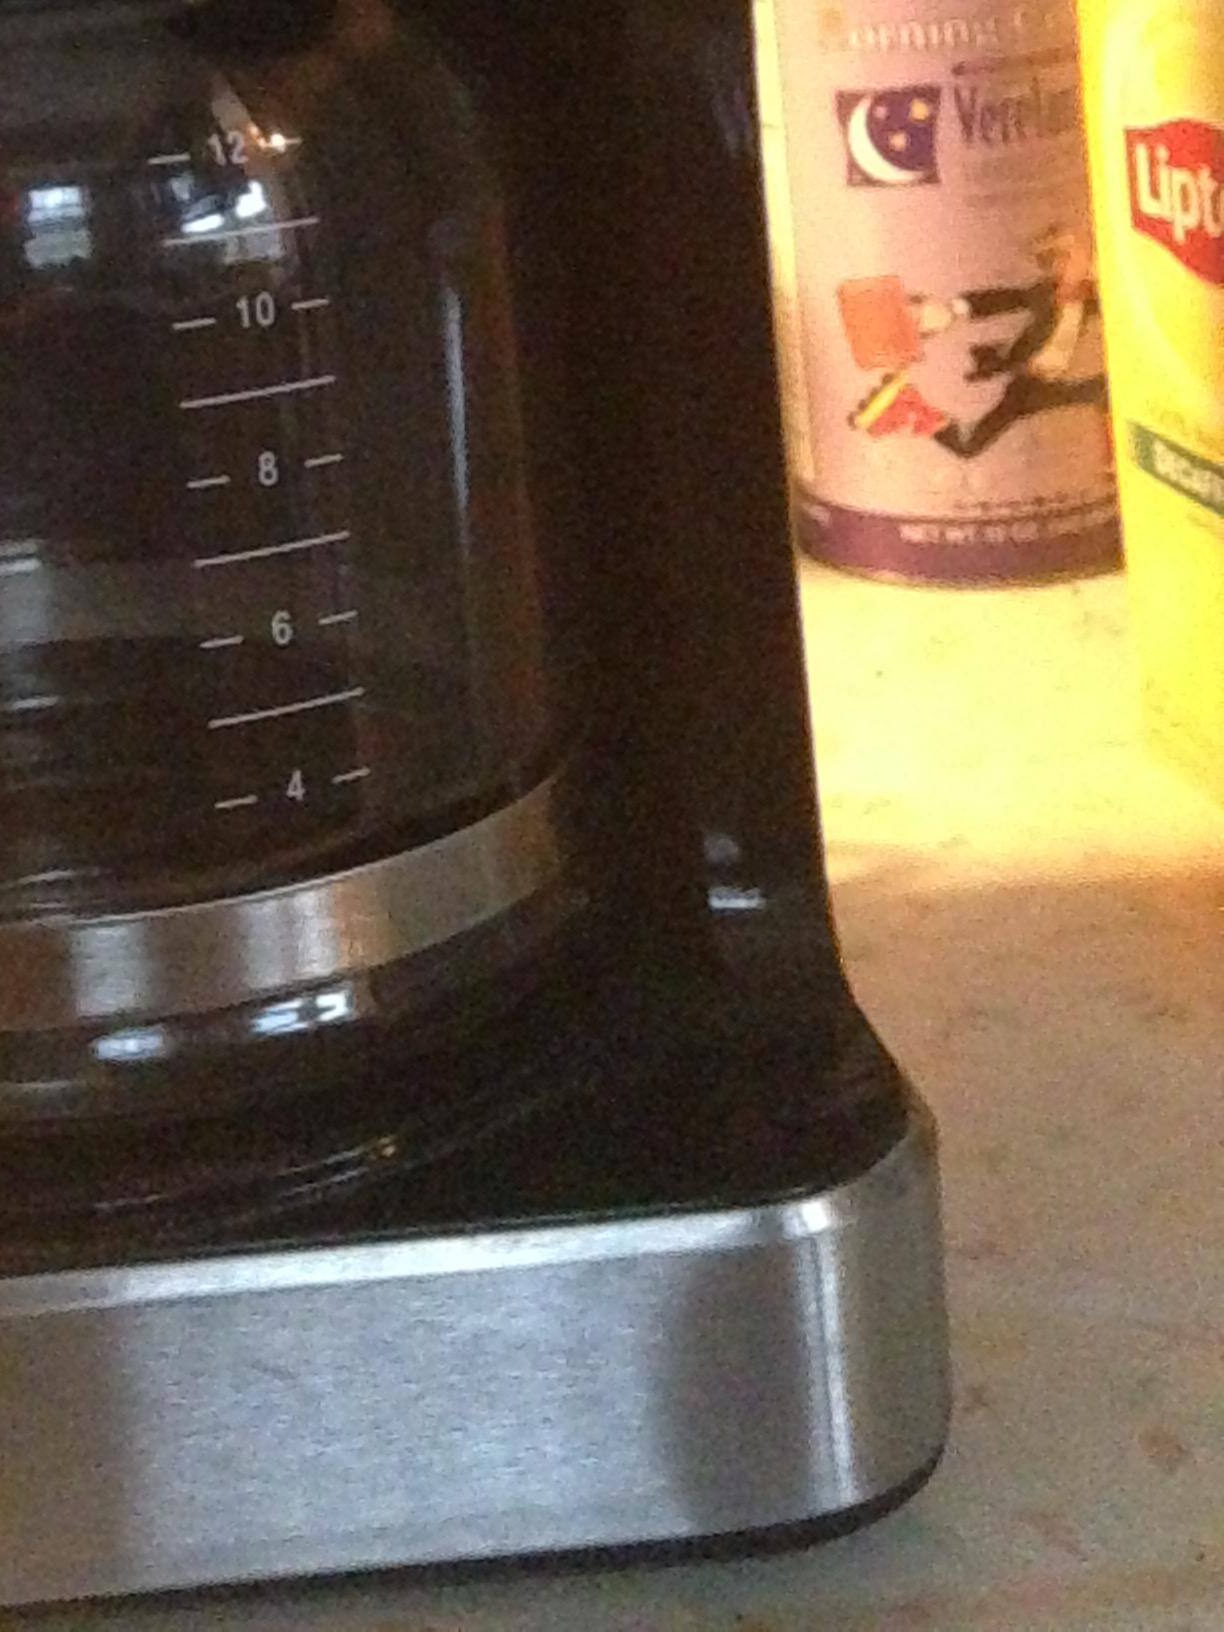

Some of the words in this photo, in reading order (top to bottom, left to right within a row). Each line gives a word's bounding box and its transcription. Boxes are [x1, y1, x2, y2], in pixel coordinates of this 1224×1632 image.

[207, 131, 250, 166] 12
[1134, 142, 1224, 244] Lipt
[235, 290, 276, 329] 10
[258, 450, 278, 487] 8
[270, 610, 294, 647] 6
[285, 769, 307, 802] 4
